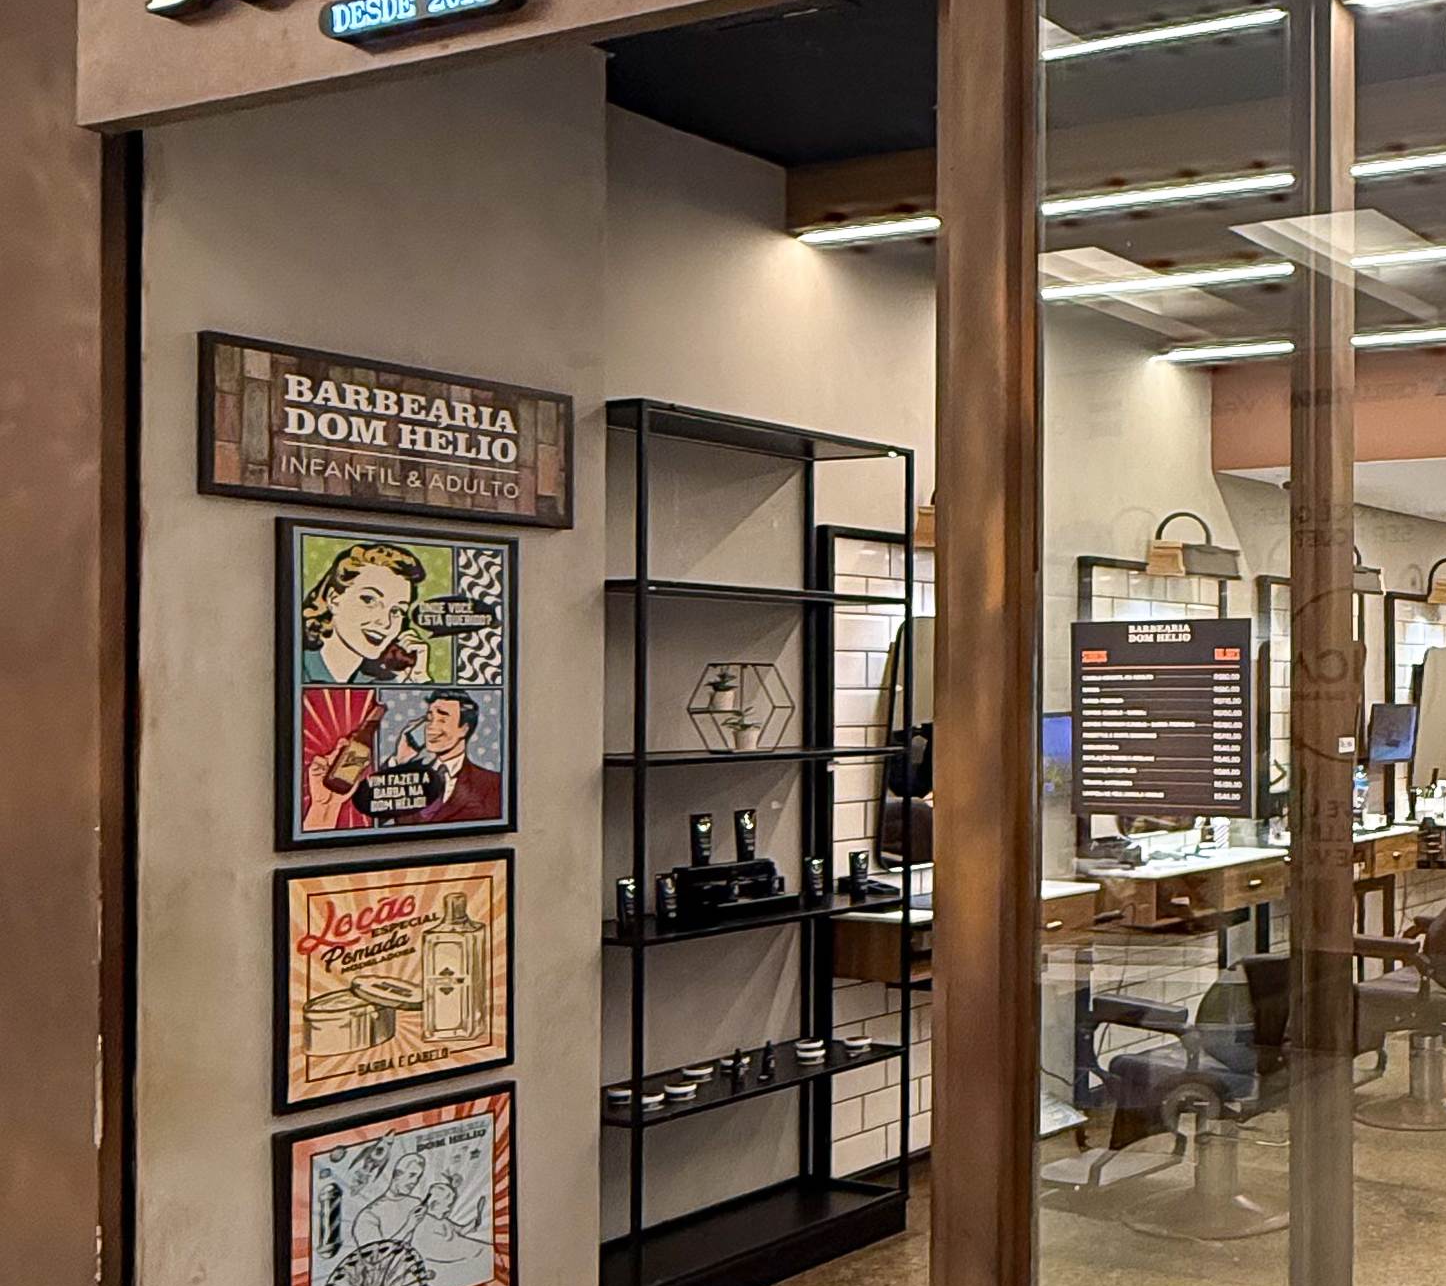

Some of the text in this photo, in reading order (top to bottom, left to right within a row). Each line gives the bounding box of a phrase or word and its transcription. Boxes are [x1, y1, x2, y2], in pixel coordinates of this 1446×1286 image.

[284, 373, 518, 435] BARBEARIA
[284, 406, 388, 446] DOM
[281, 455, 520, 500] INFANTIL & ADULTO
[387, 772, 420, 786] FAZER
[421, 771, 430, 784] A
[408, 784, 424, 796] NA
[371, 912, 440, 939] ESPECIAL
[321, 930, 411, 973] Pomada
[357, 1047, 449, 1076] BARBA E CABELO
